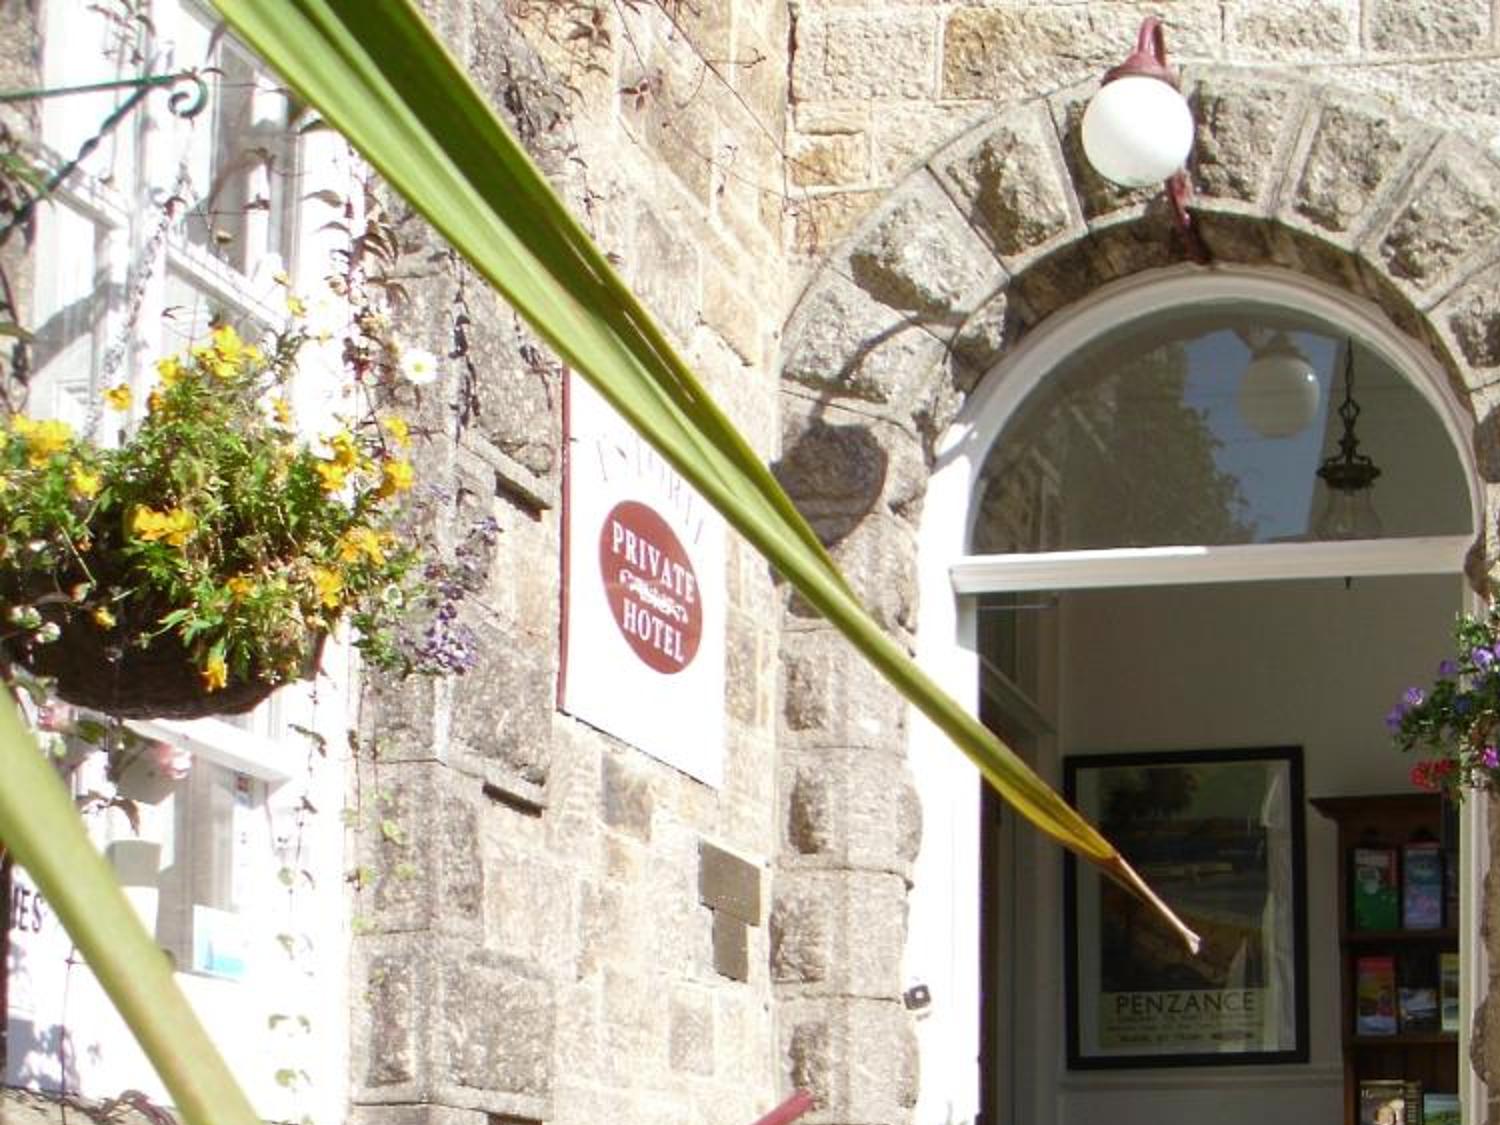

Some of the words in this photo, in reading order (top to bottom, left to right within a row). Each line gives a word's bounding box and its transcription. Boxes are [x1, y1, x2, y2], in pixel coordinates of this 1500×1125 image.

[612, 520, 696, 603] PRIVATE
[622, 598, 686, 664] HOTEL
[1116, 990, 1256, 1015] PENZANCE
